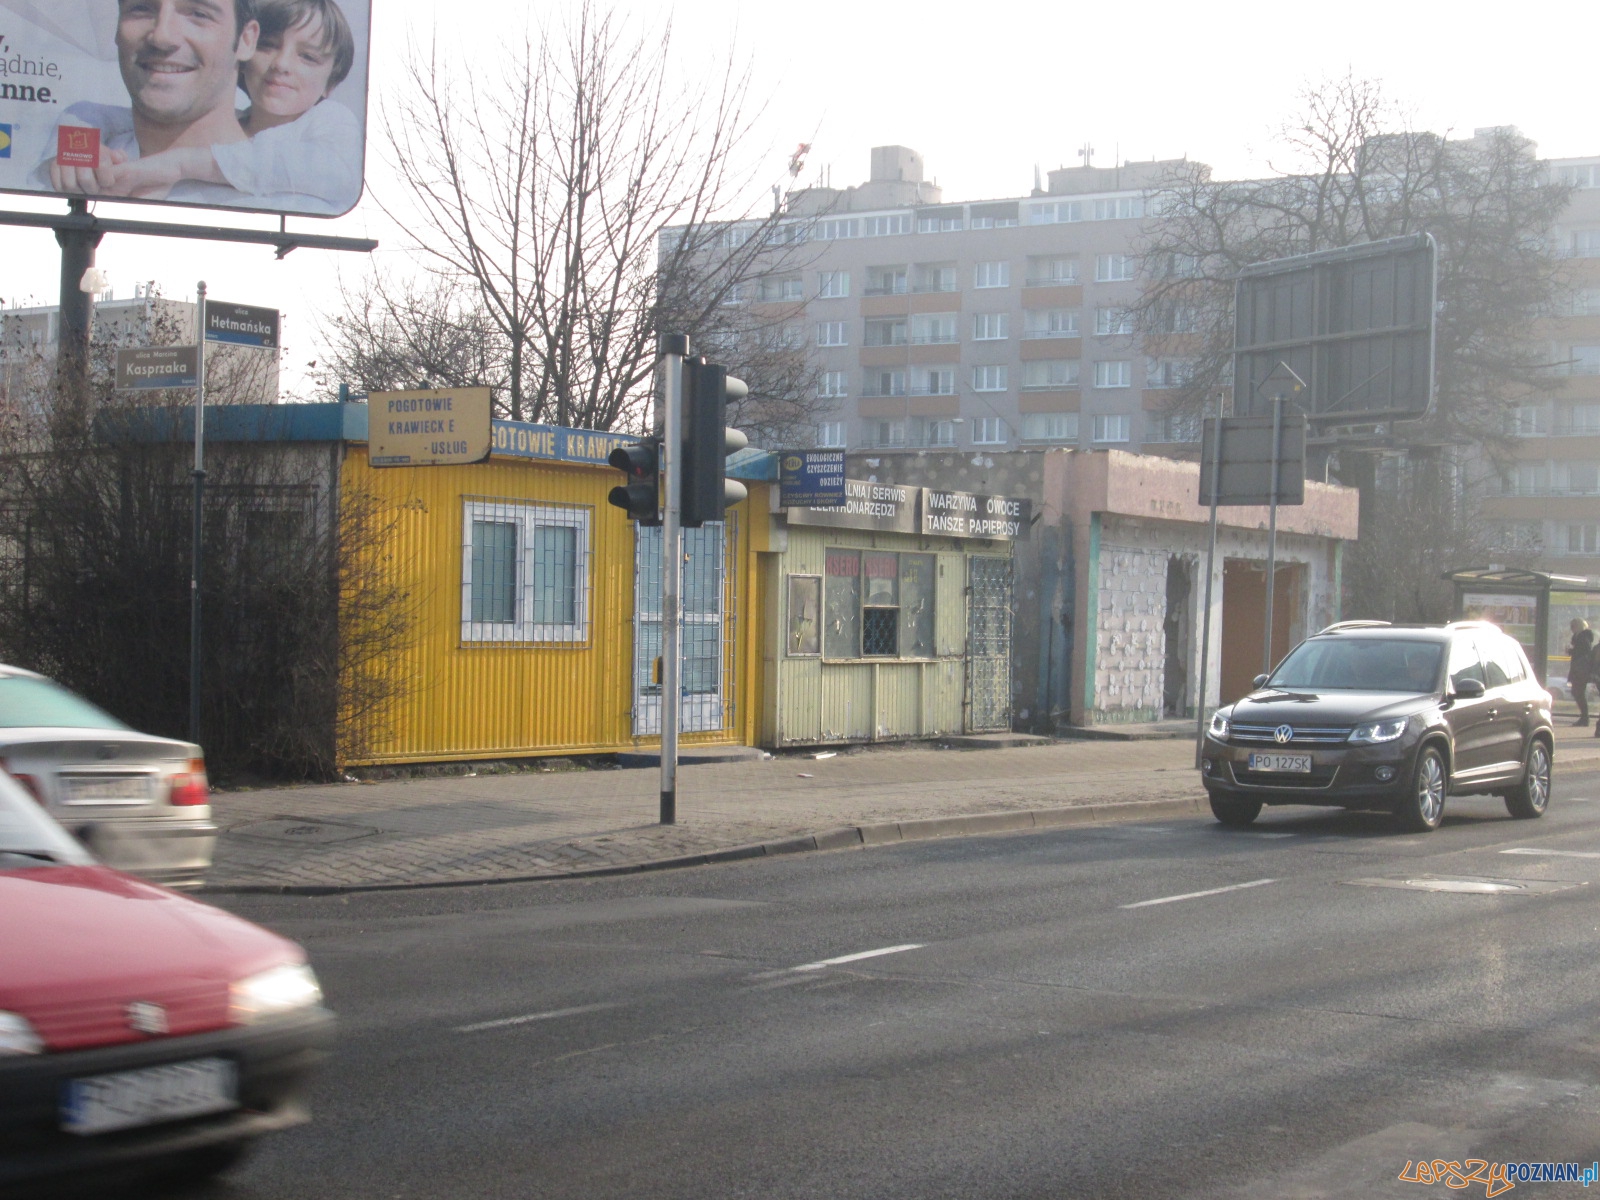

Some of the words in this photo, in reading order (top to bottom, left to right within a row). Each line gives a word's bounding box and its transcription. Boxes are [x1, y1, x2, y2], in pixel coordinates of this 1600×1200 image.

[235, 307, 249, 315] ulica
[211, 314, 271, 335] Hetmańska
[135, 351, 151, 359] ulica
[126, 361, 187, 378] Kasprzaka
[388, 397, 453, 413] POGOTOWIE
[431, 440, 468, 455] USŁUG
[806, 452, 843, 462] EKOLOGICZNE
[806, 464, 843, 474] CZYSZCZENIE
[819, 475, 844, 486] ODZIEŻY
[867, 487, 871, 499] I
[872, 487, 906, 503] SERWIS
[929, 493, 977, 512] WARZYWA
[987, 498, 1020, 517] OWOCE
[927, 512, 964, 532] TAŃSZE
[969, 519, 1020, 536] PAPIEROSY
[825, 555, 860, 577] KSERO
[865, 556, 898, 578] KSERO
[1255, 756, 1271, 768] PO
[1275, 757, 1309, 770] 127SK
